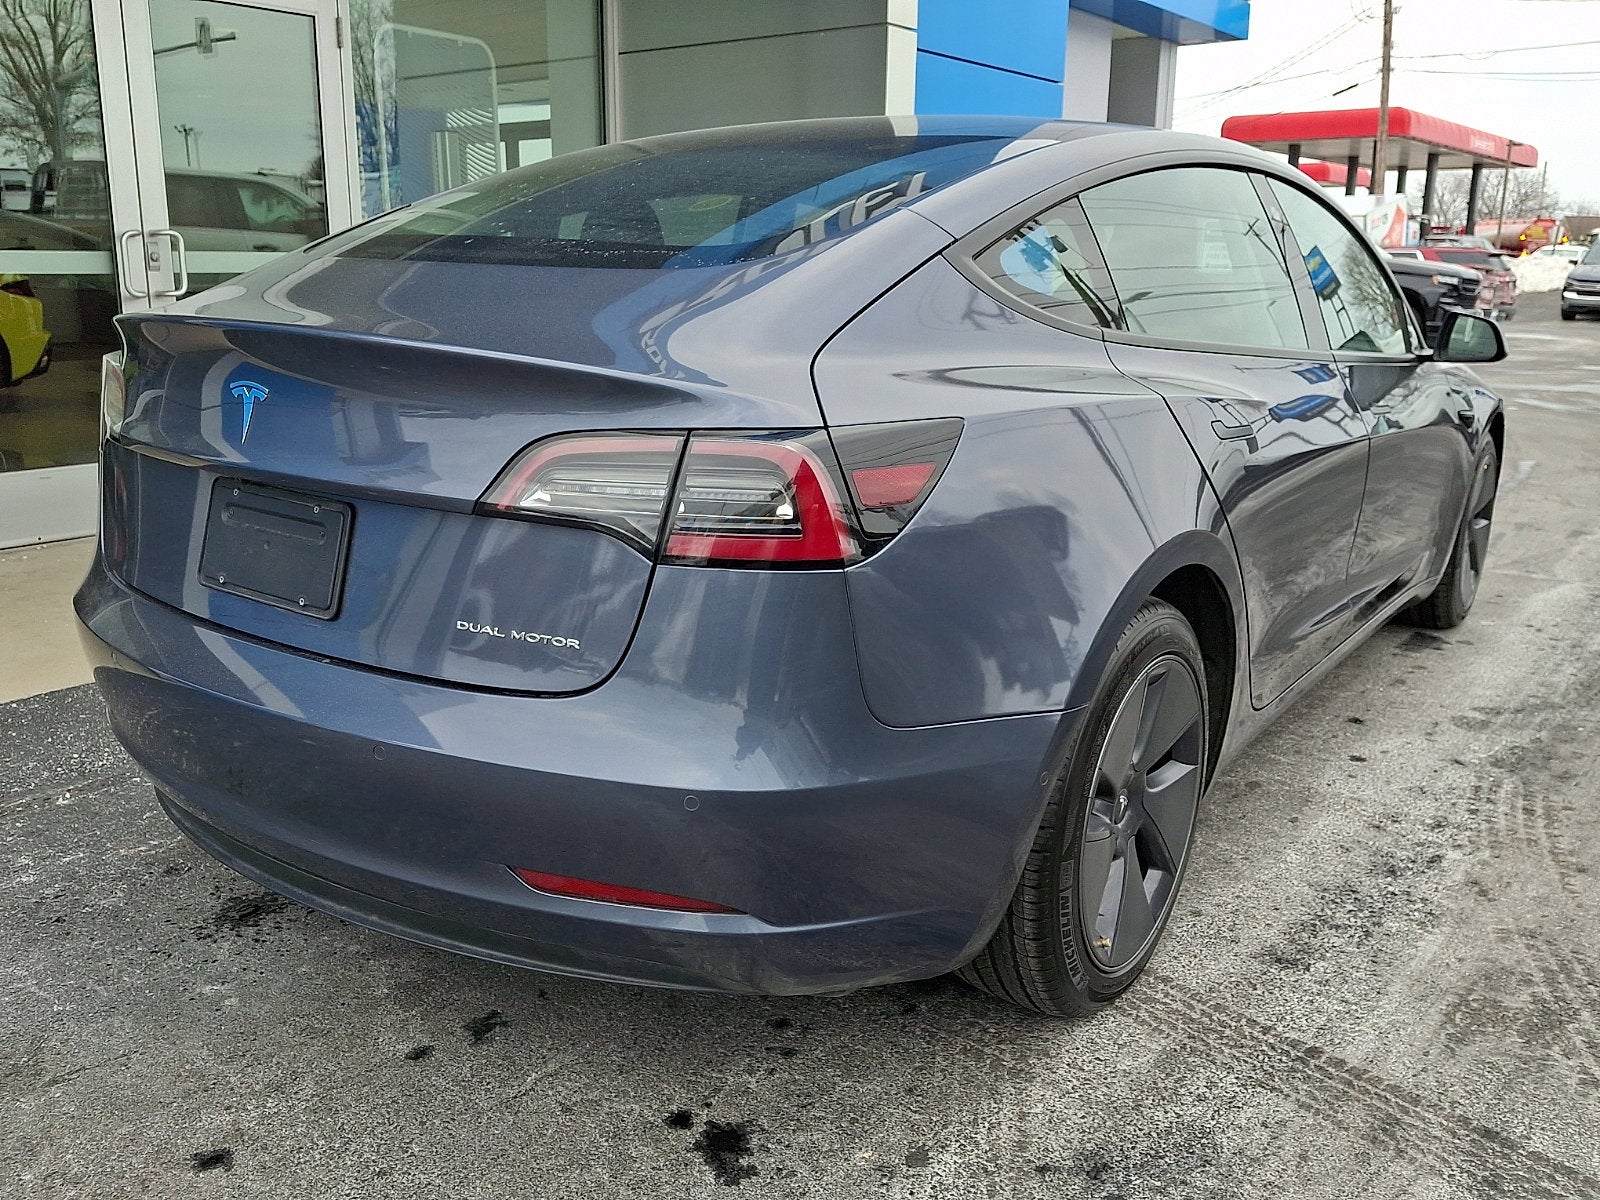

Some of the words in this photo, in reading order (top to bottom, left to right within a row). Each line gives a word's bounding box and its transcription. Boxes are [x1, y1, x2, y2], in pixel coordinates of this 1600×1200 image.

[456, 620, 506, 638] DUAL
[510, 630, 580, 650] MOTOR
[1060, 895, 1082, 979] MICHELIN
